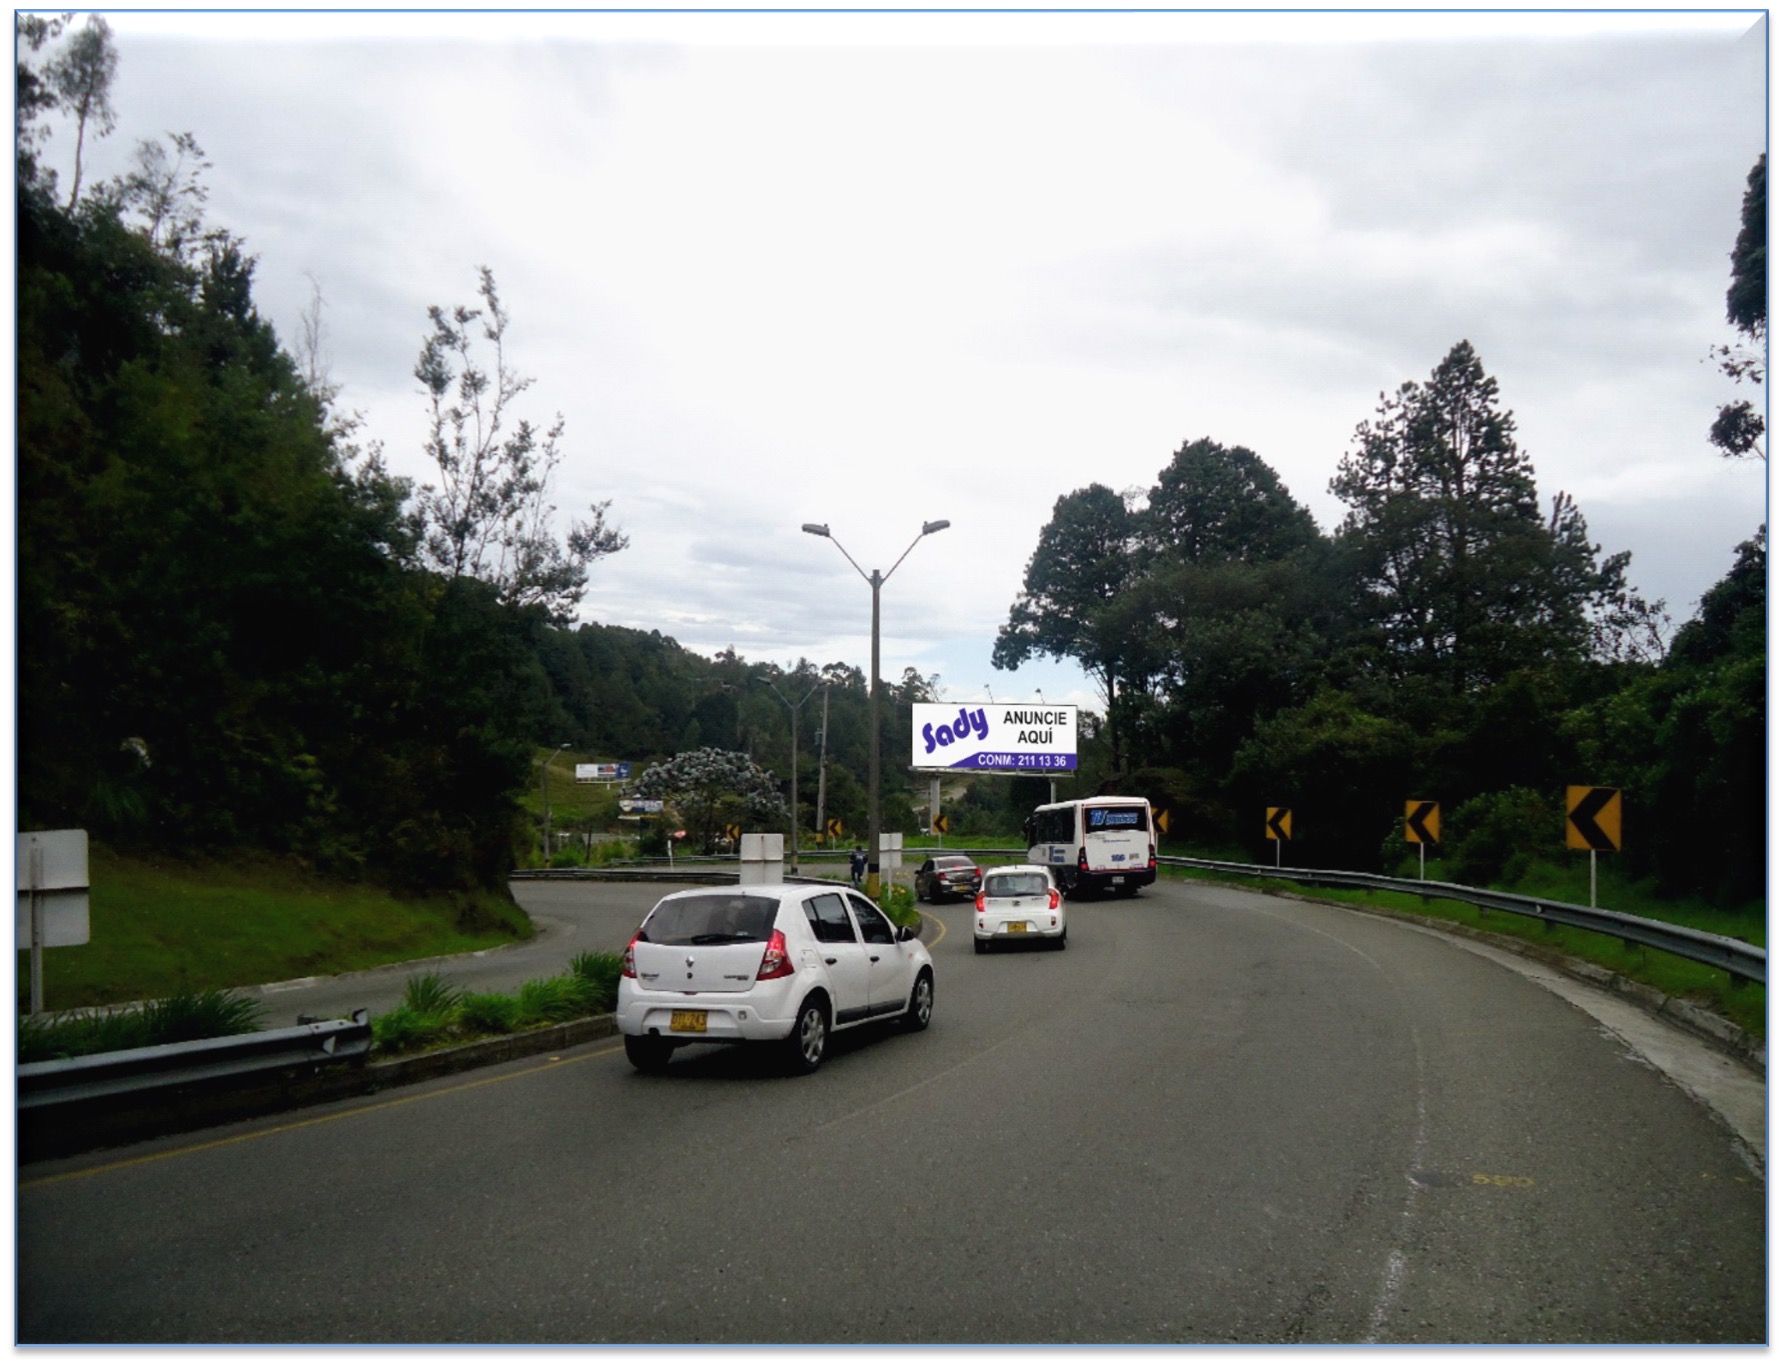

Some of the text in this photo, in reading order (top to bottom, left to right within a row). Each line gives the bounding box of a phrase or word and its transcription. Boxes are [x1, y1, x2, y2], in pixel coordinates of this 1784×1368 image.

[1003, 711, 1067, 725] ANUNCIE
[922, 708, 989, 754] Sady
[1017, 727, 1053, 744] AQUÍ
[978, 754, 1066, 767] CONM: 211 13 36
